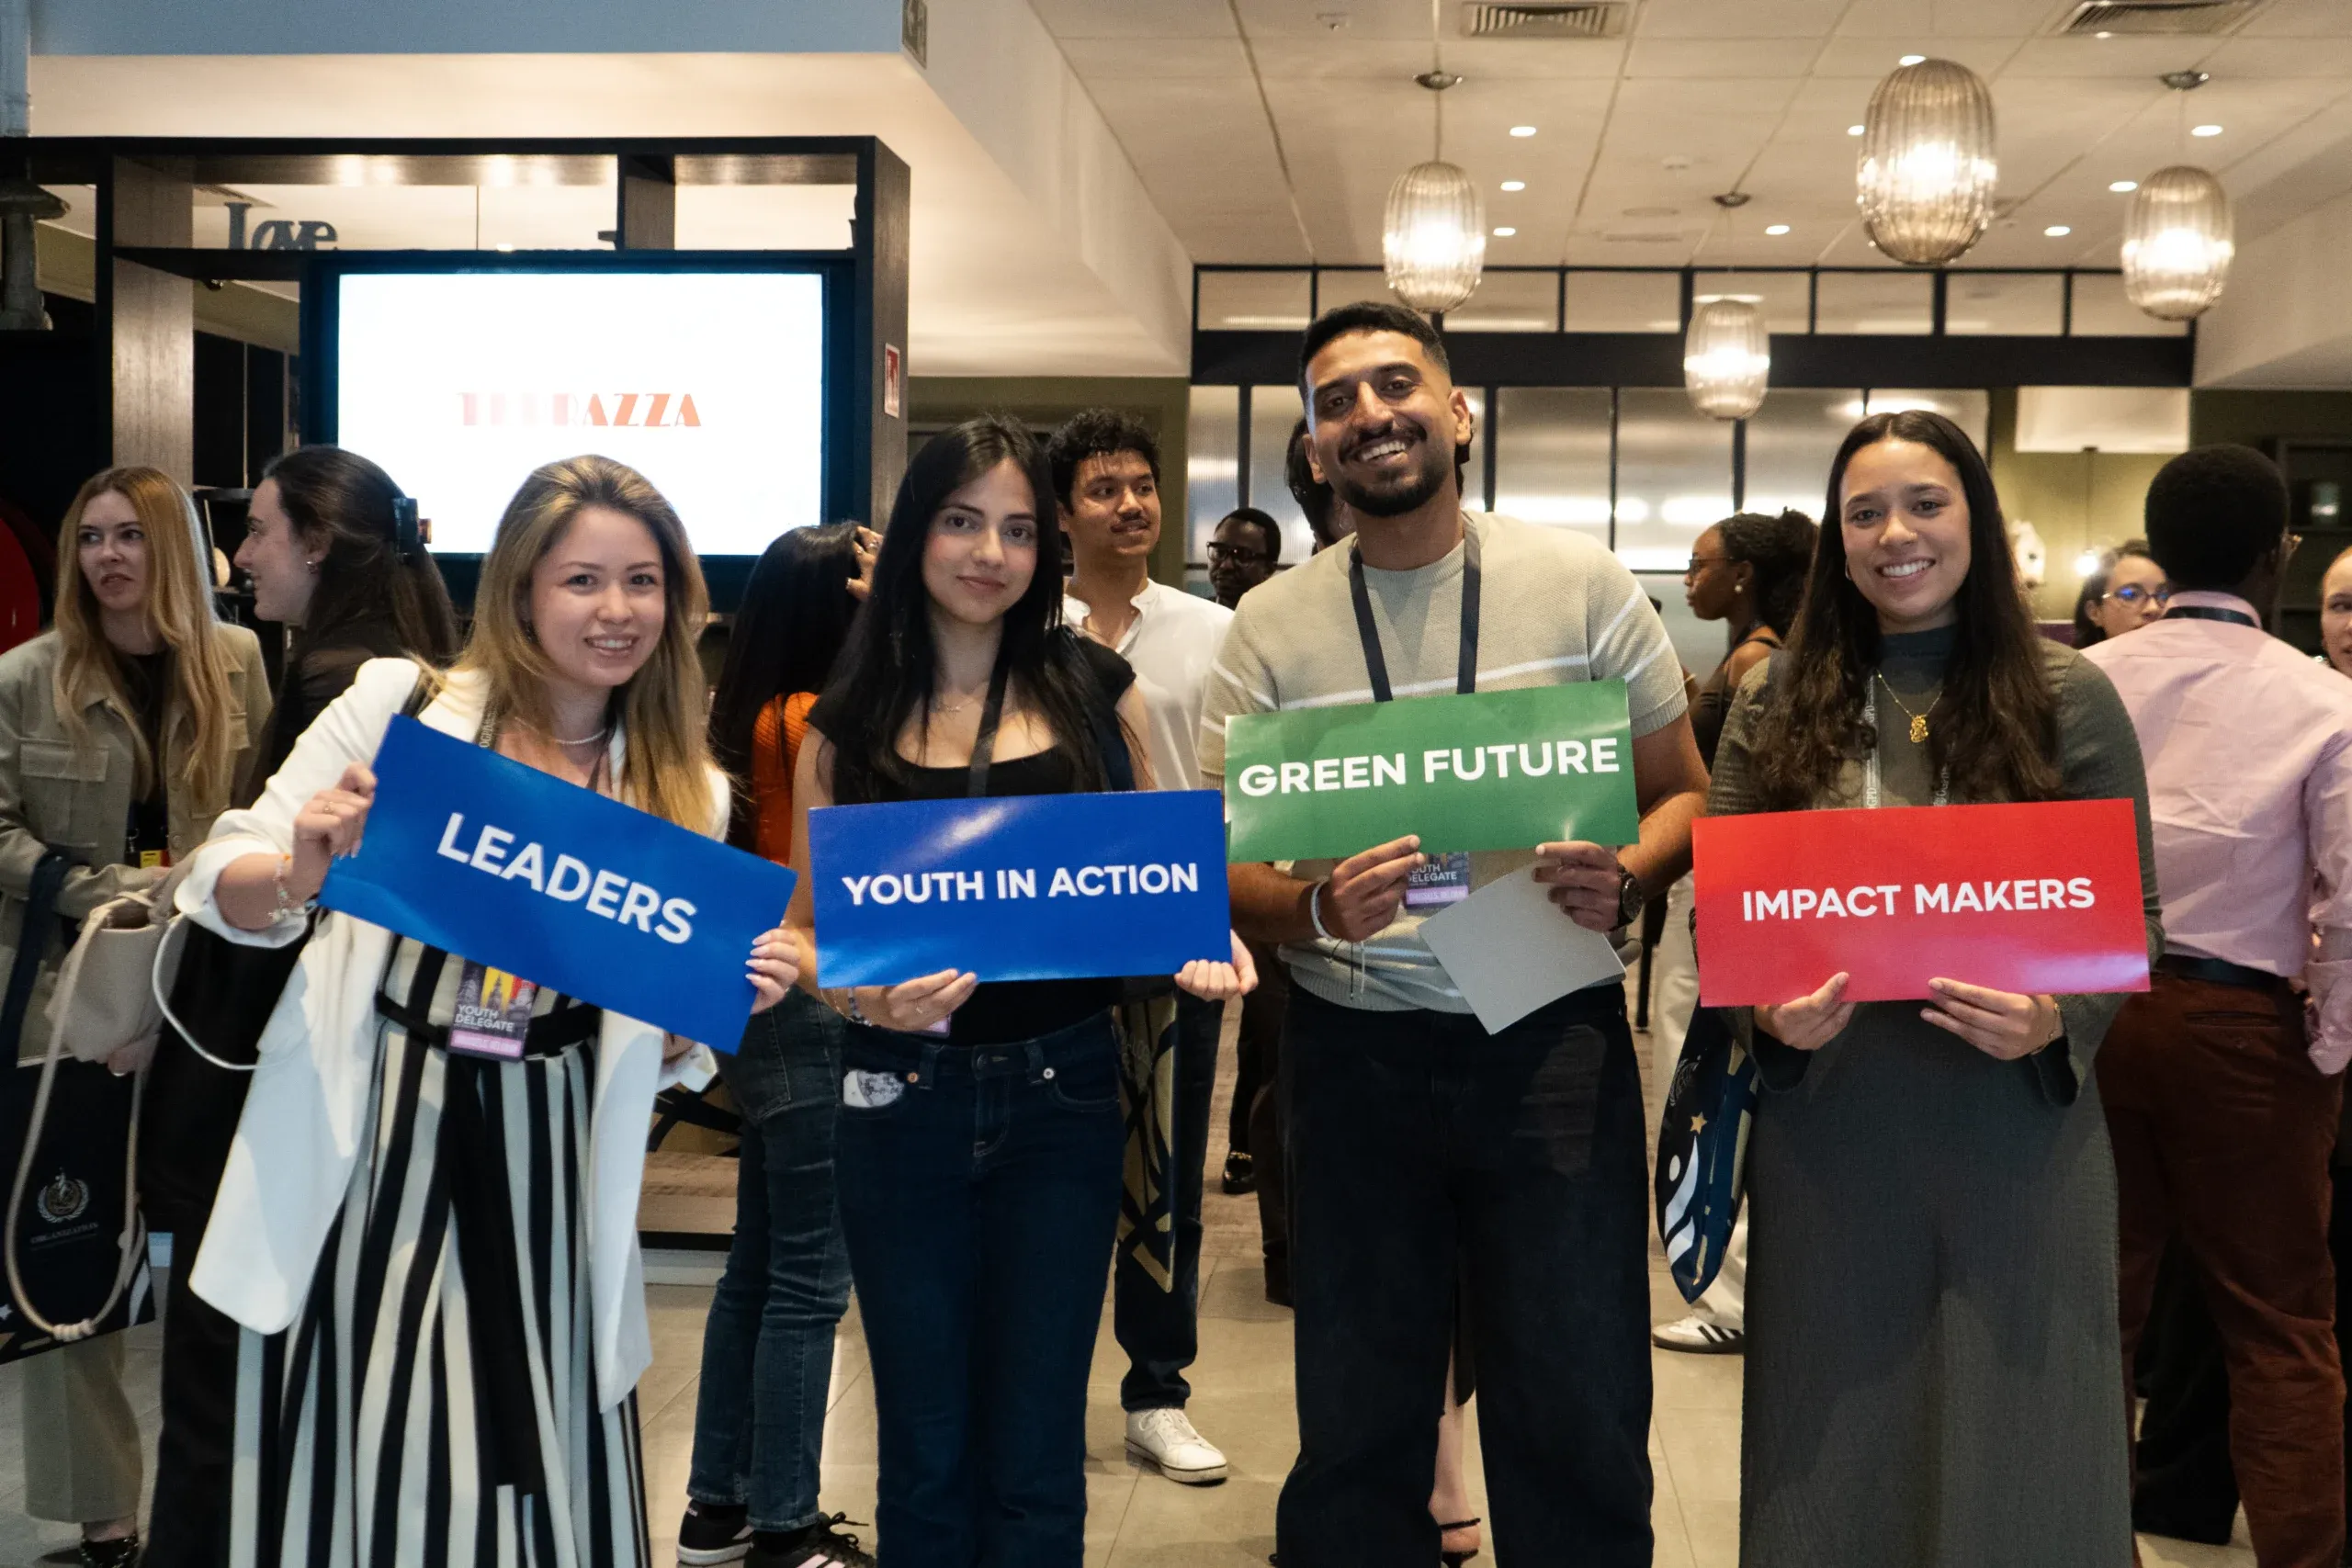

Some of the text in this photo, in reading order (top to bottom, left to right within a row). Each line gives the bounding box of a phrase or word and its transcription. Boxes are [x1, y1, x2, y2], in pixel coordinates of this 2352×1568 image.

[1238, 738, 1620, 796] GREEN FUTURE
[436, 812, 697, 944] LEADERS
[842, 863, 1198, 906] YOUTH IN ACTION
[1743, 877, 2095, 921] IMPACT MAKERS
[455, 1013, 514, 1032] DELEGATE
[458, 1005, 498, 1019] YOUTH
